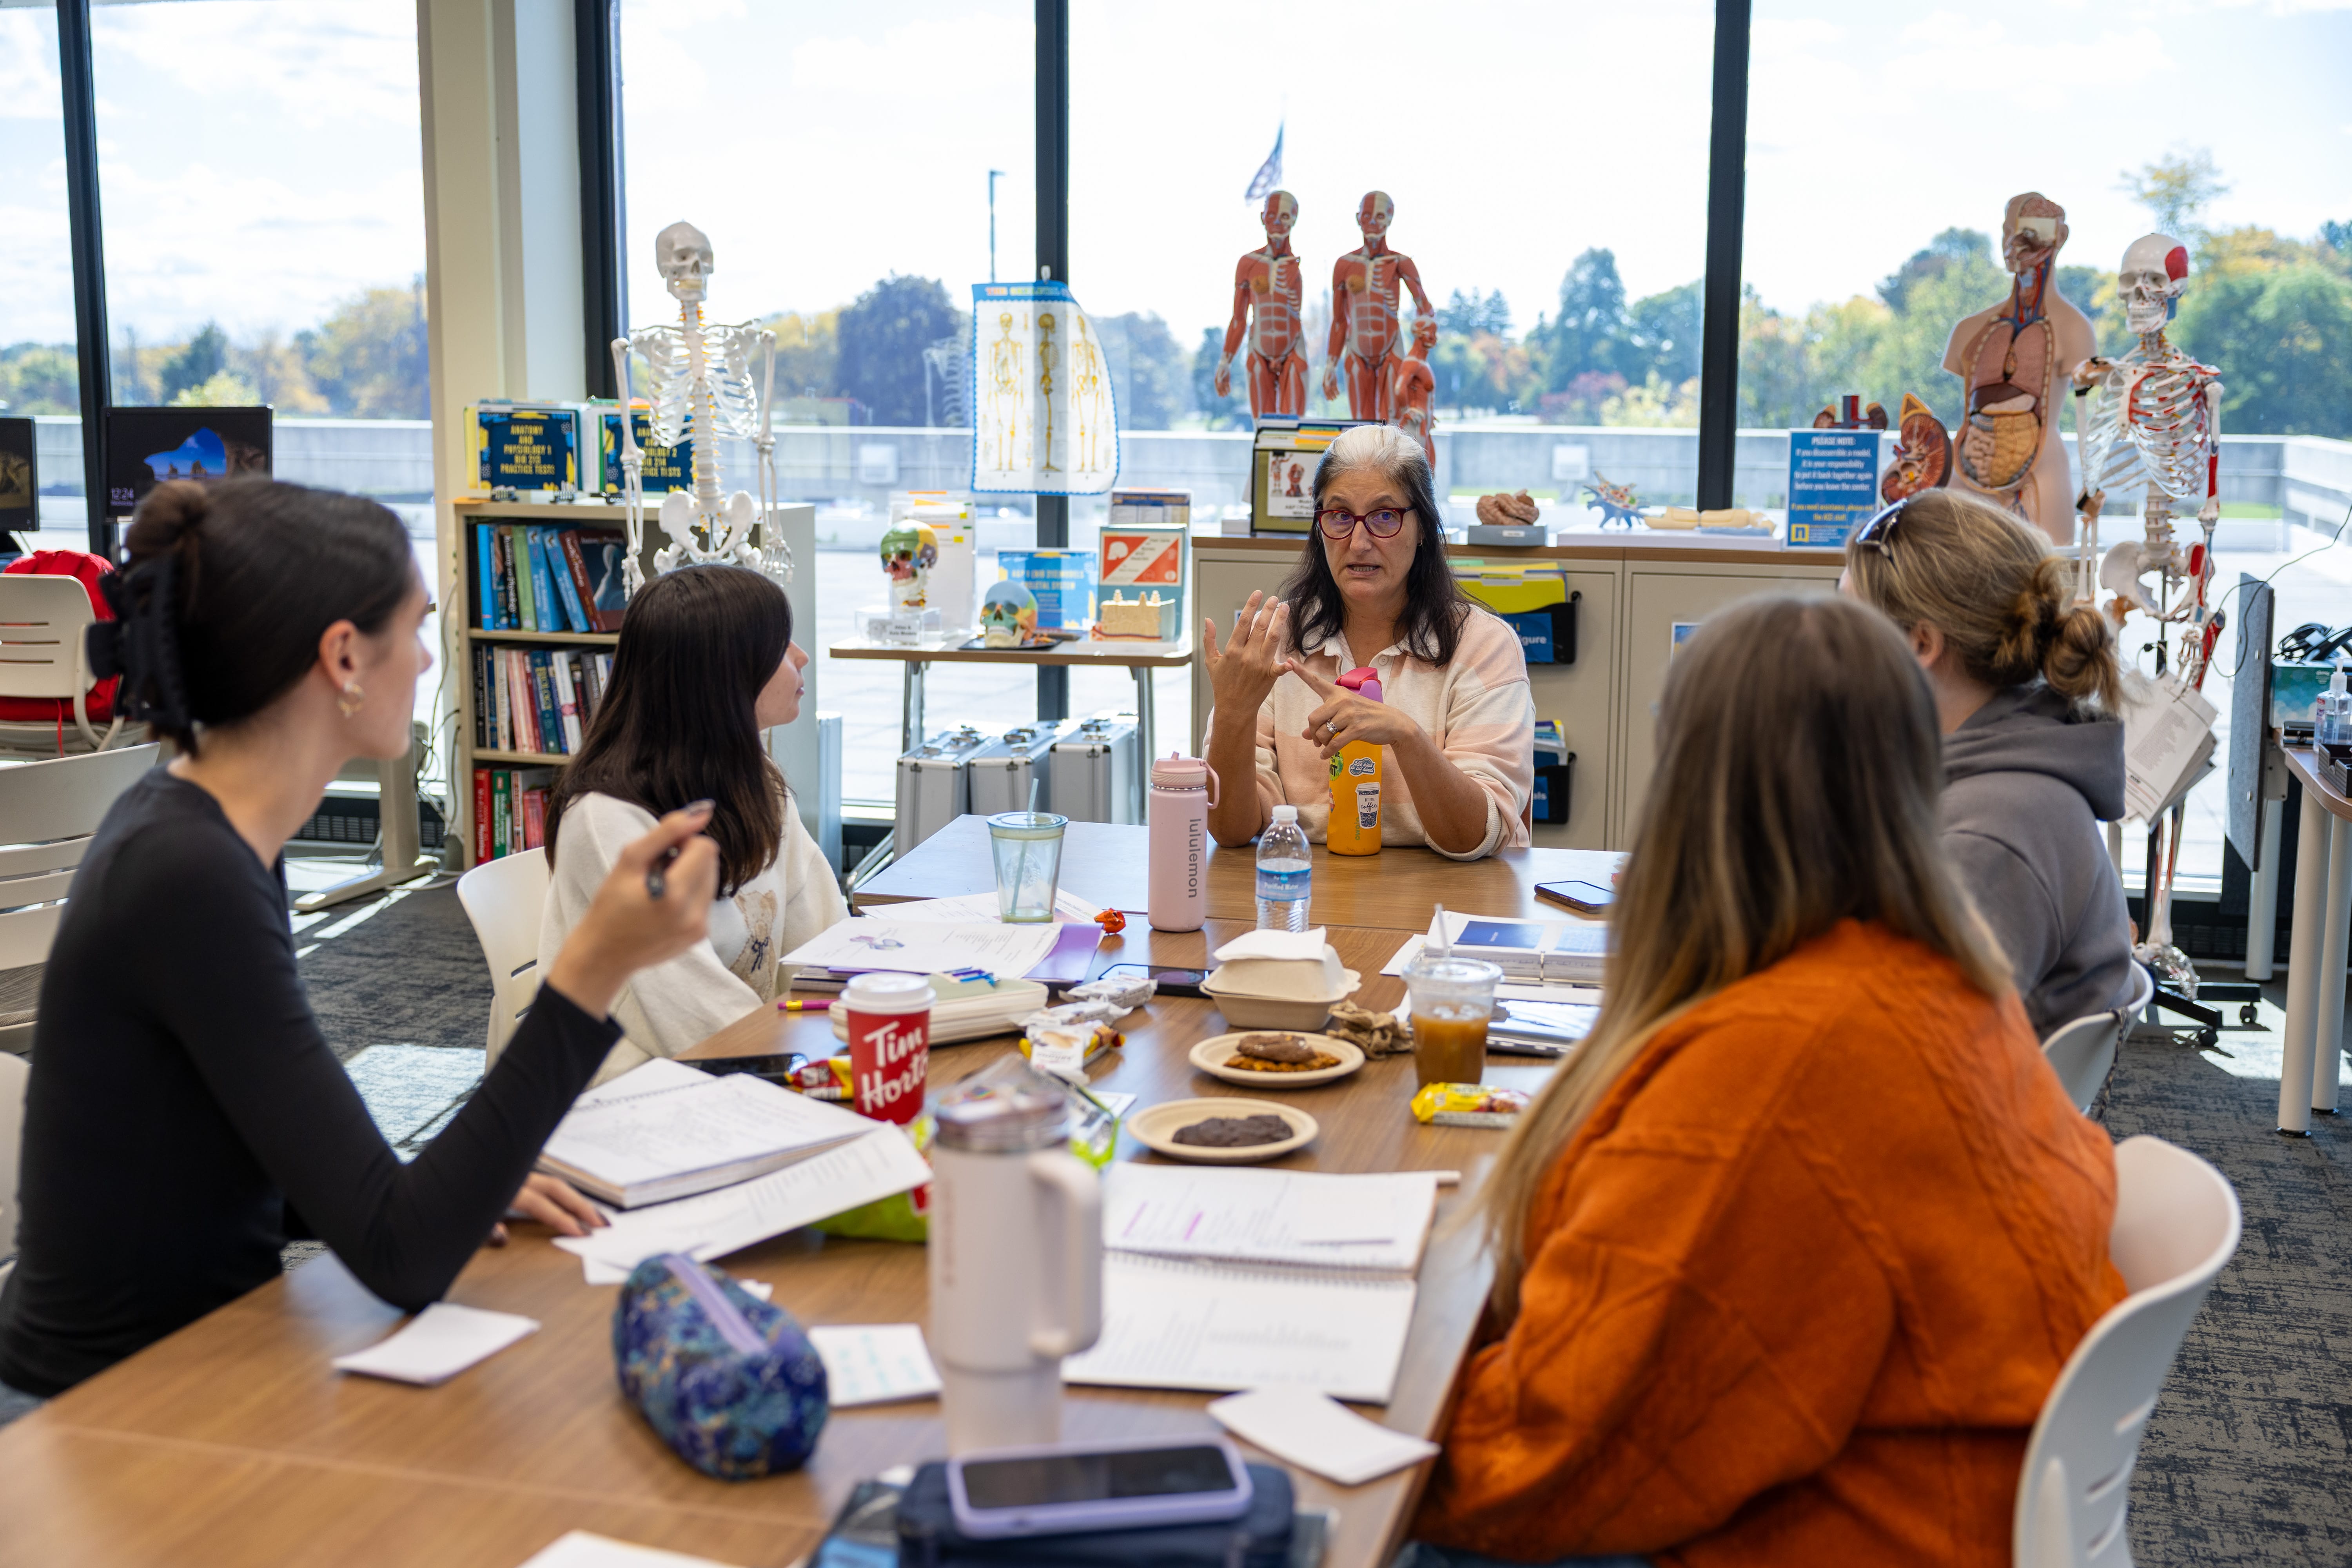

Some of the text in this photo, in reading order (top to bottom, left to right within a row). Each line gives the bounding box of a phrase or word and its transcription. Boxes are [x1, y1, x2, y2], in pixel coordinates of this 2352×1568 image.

[511, 425, 544, 435] ANATOMY
[519, 435, 534, 445] AND
[1811, 436, 1836, 445] PLEASE
[504, 444, 545, 455] PHYSIOLOGY
[672, 447, 677, 457] 2
[1813, 448, 1845, 456] disassemble
[514, 455, 526, 464] BIO
[1828, 460, 1864, 469] responsibility
[500, 463, 555, 475] PRACTICE TESTS
[661, 467, 681, 477] TESTS
[1833, 471, 1855, 481] together
[1857, 472, 1873, 481] again
[1795, 481, 1813, 490] before
[1826, 482, 1839, 490] leave
[111, 488, 134, 499] 12:24
[535, 667, 553, 710] BIOLOGY
[1188, 818, 1201, 898] lululemon
[1264, 882, 1284, 890] Purified
[863, 1021, 923, 1068] Tim
